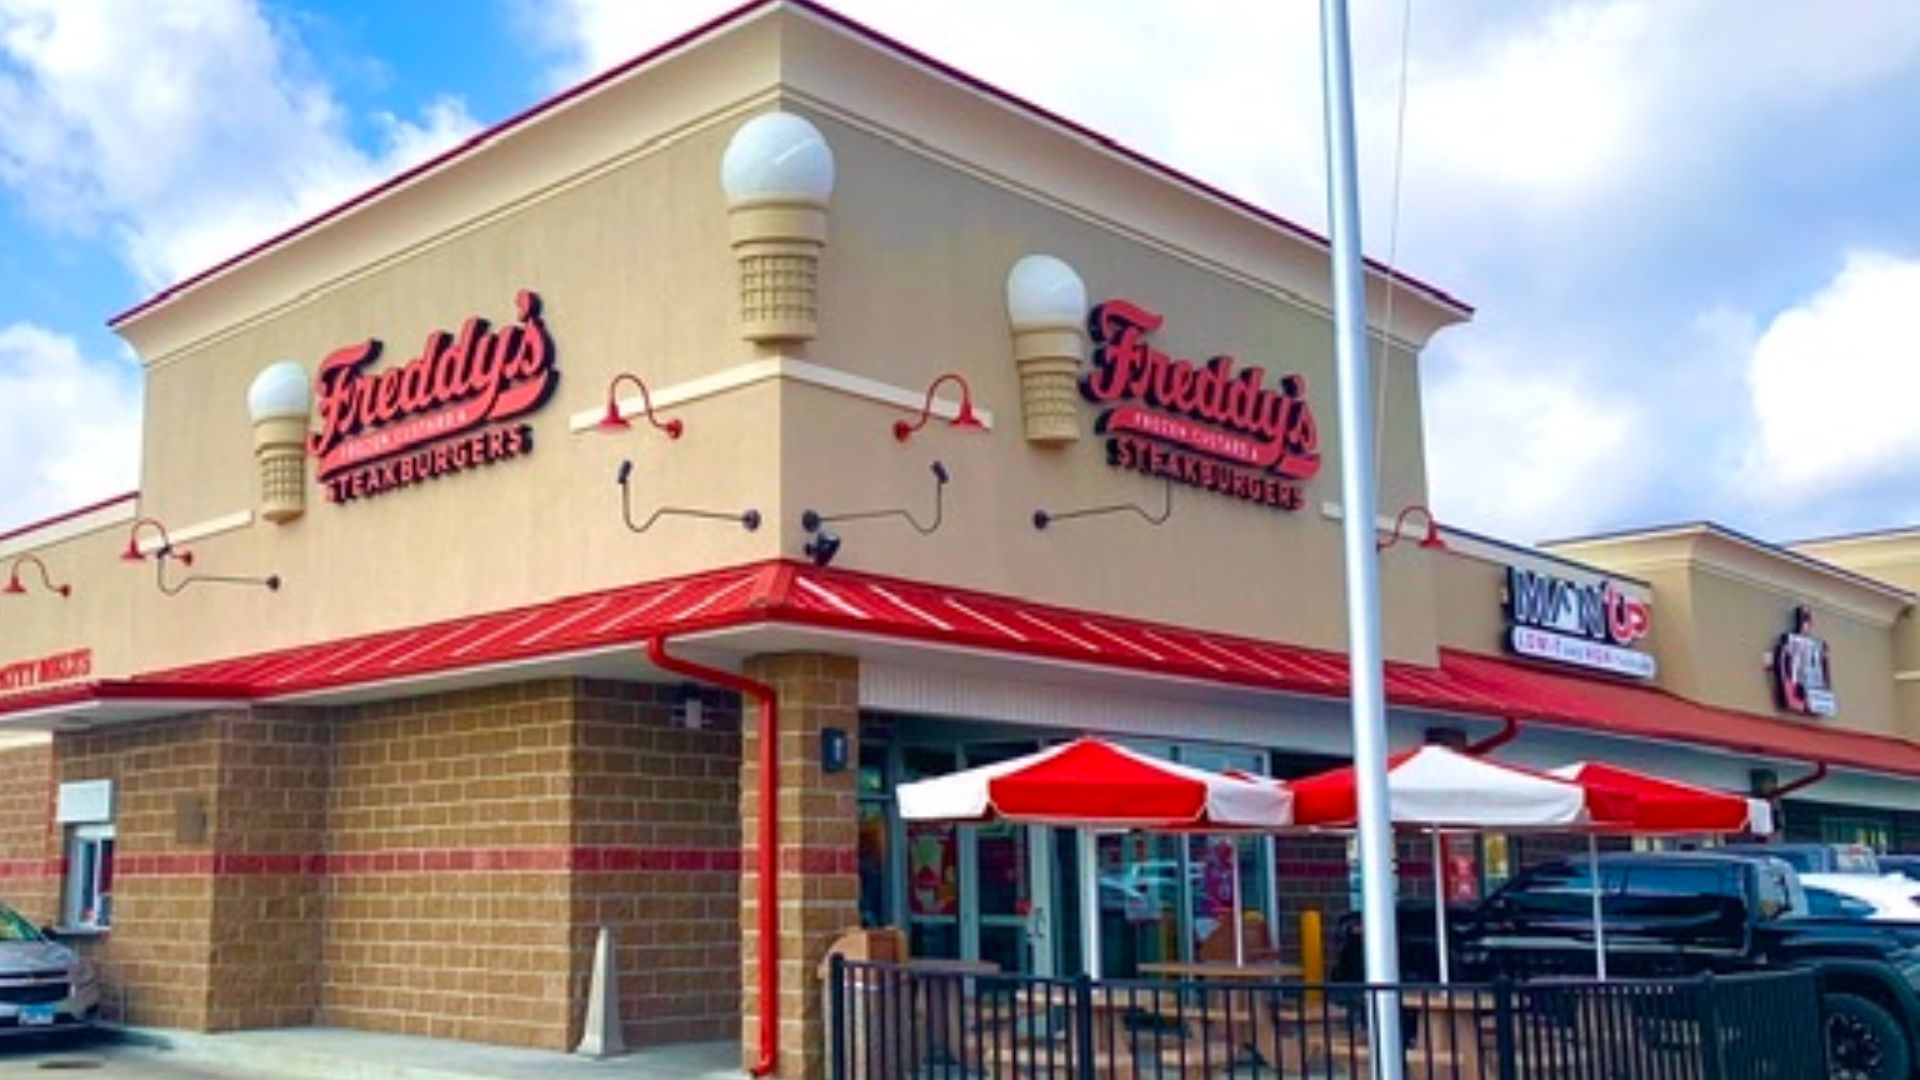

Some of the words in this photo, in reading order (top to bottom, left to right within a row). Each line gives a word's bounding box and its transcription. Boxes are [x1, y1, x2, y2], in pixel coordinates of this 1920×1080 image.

[307, 288, 559, 458] Freddy's
[1081, 299, 1320, 476] Freddy's
[325, 424, 533, 503] STEAKBURGERS
[1107, 438, 1305, 511] STEAKBURGERS
[1509, 565, 1607, 639] MAN
